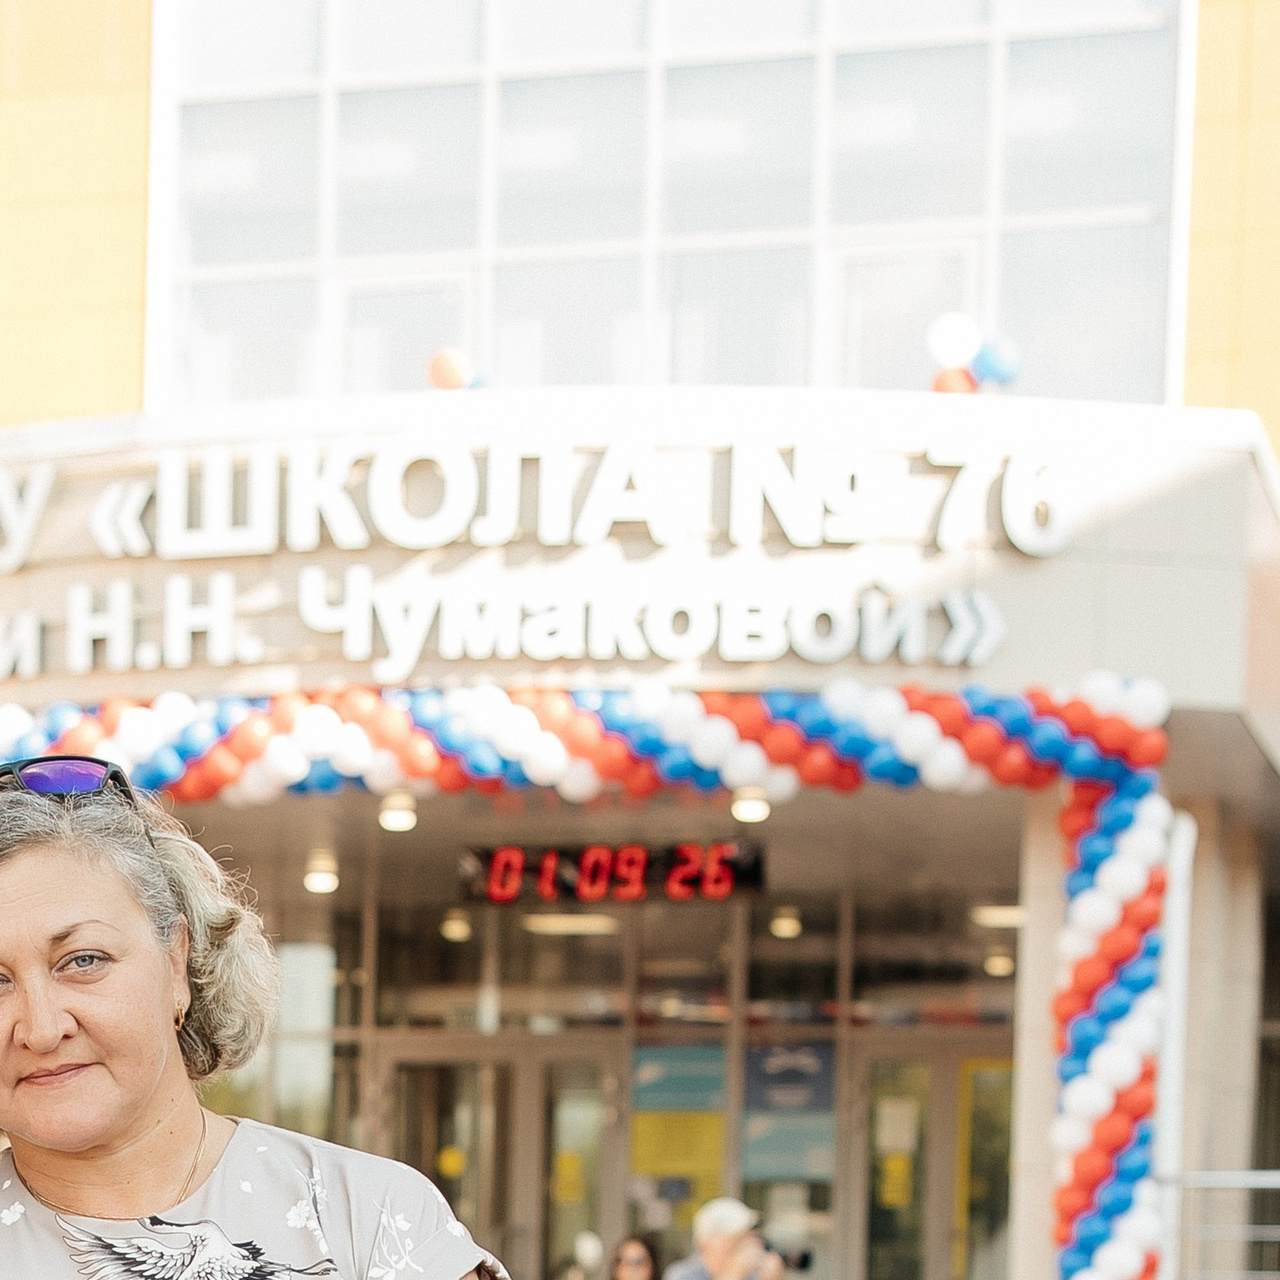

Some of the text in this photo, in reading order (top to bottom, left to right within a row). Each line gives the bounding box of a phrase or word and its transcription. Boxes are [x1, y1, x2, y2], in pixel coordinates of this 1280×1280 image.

[89, 440, 690, 560] «ШКОЛА
[923, 444, 1073, 558] 76
[65, 573, 265, 674] Н.Н.
[297, 563, 1008, 683] Чумаковой»
